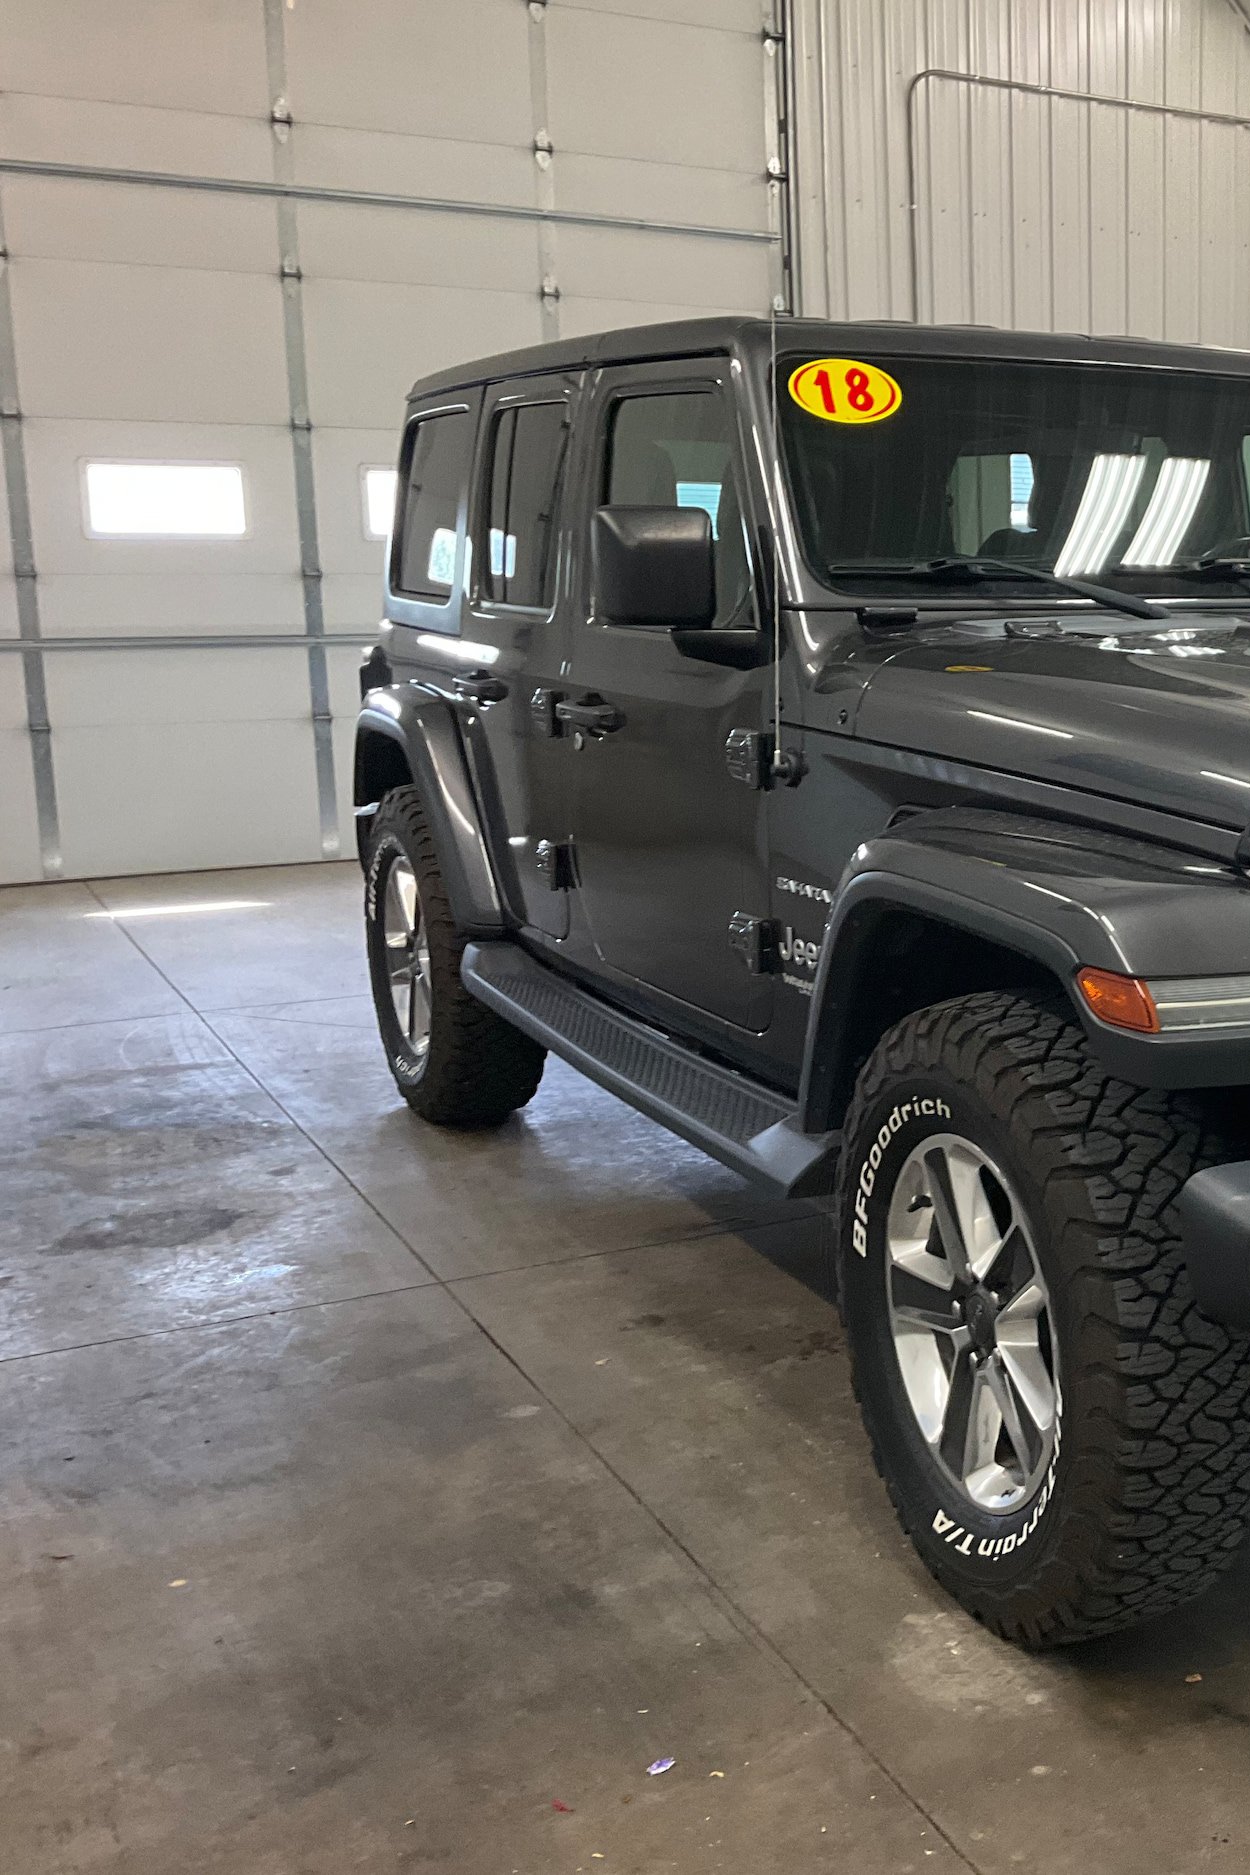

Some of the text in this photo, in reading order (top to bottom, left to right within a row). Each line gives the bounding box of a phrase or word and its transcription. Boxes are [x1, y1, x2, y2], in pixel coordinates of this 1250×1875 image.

[813, 368, 874, 414] 18
[778, 926, 821, 970] Jee
[852, 1095, 951, 1258] BFGoodrich
[931, 1508, 975, 1556] T/A
